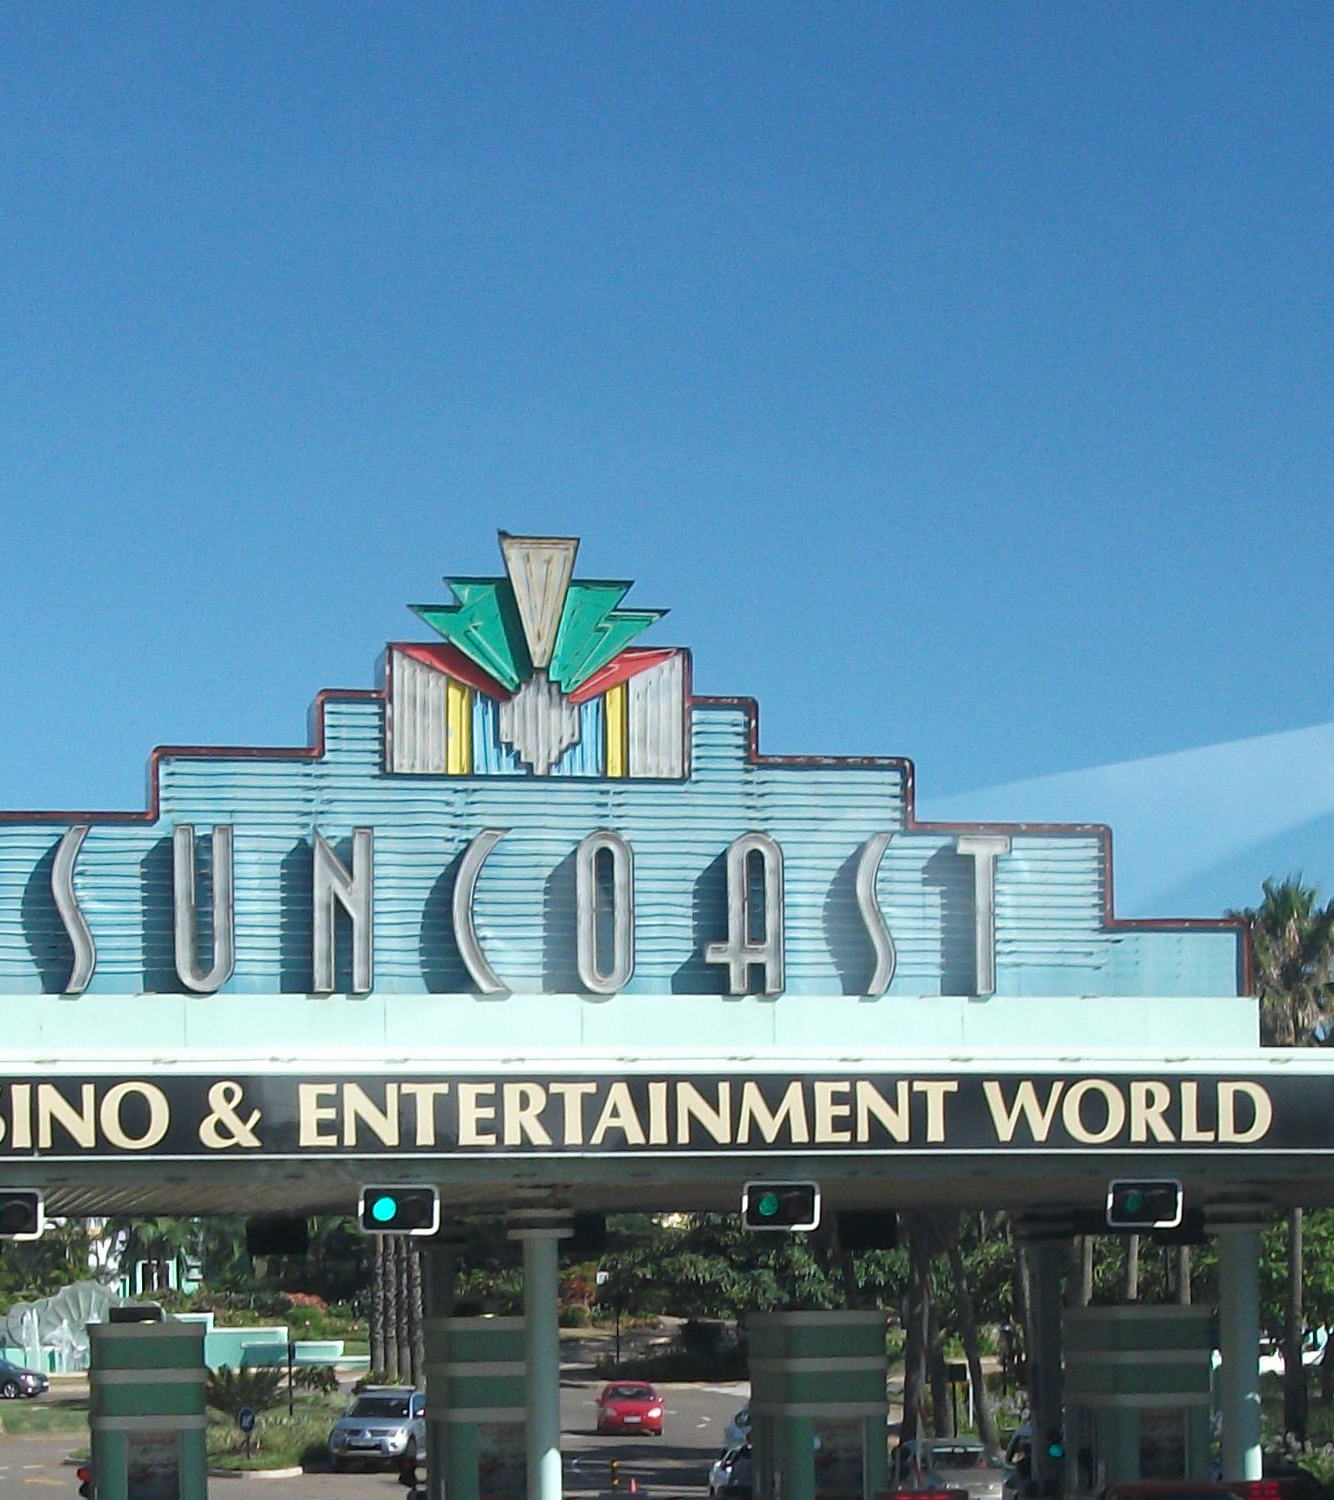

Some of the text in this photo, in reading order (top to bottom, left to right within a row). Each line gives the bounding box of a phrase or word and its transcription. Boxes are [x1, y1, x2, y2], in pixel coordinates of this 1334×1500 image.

[198, 1081, 263, 1150] &
[297, 1080, 959, 1150] ENTERTAINMENT
[982, 1079, 1274, 1145] WORLD
